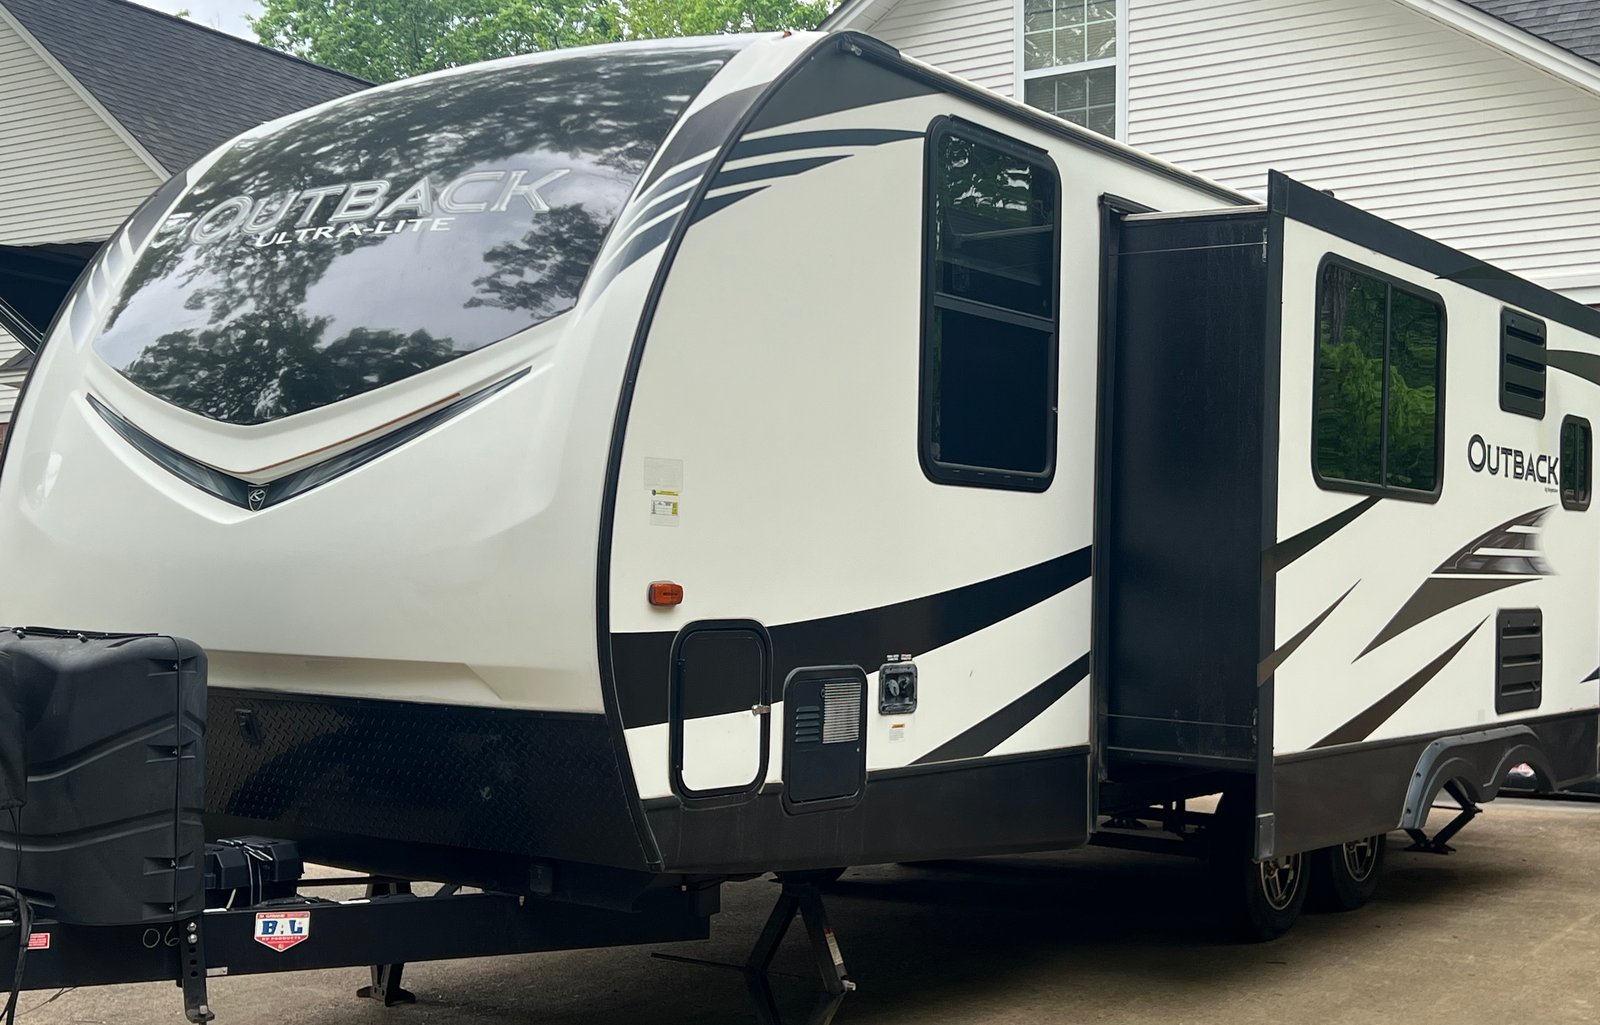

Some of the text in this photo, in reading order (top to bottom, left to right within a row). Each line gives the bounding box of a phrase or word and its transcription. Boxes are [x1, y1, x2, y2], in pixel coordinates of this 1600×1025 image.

[190, 168, 571, 246] OUTBACK
[255, 217, 455, 247] ULTRA-LITE
[1467, 434, 1559, 485] OUTBACK
[142, 926, 180, 949] 06
